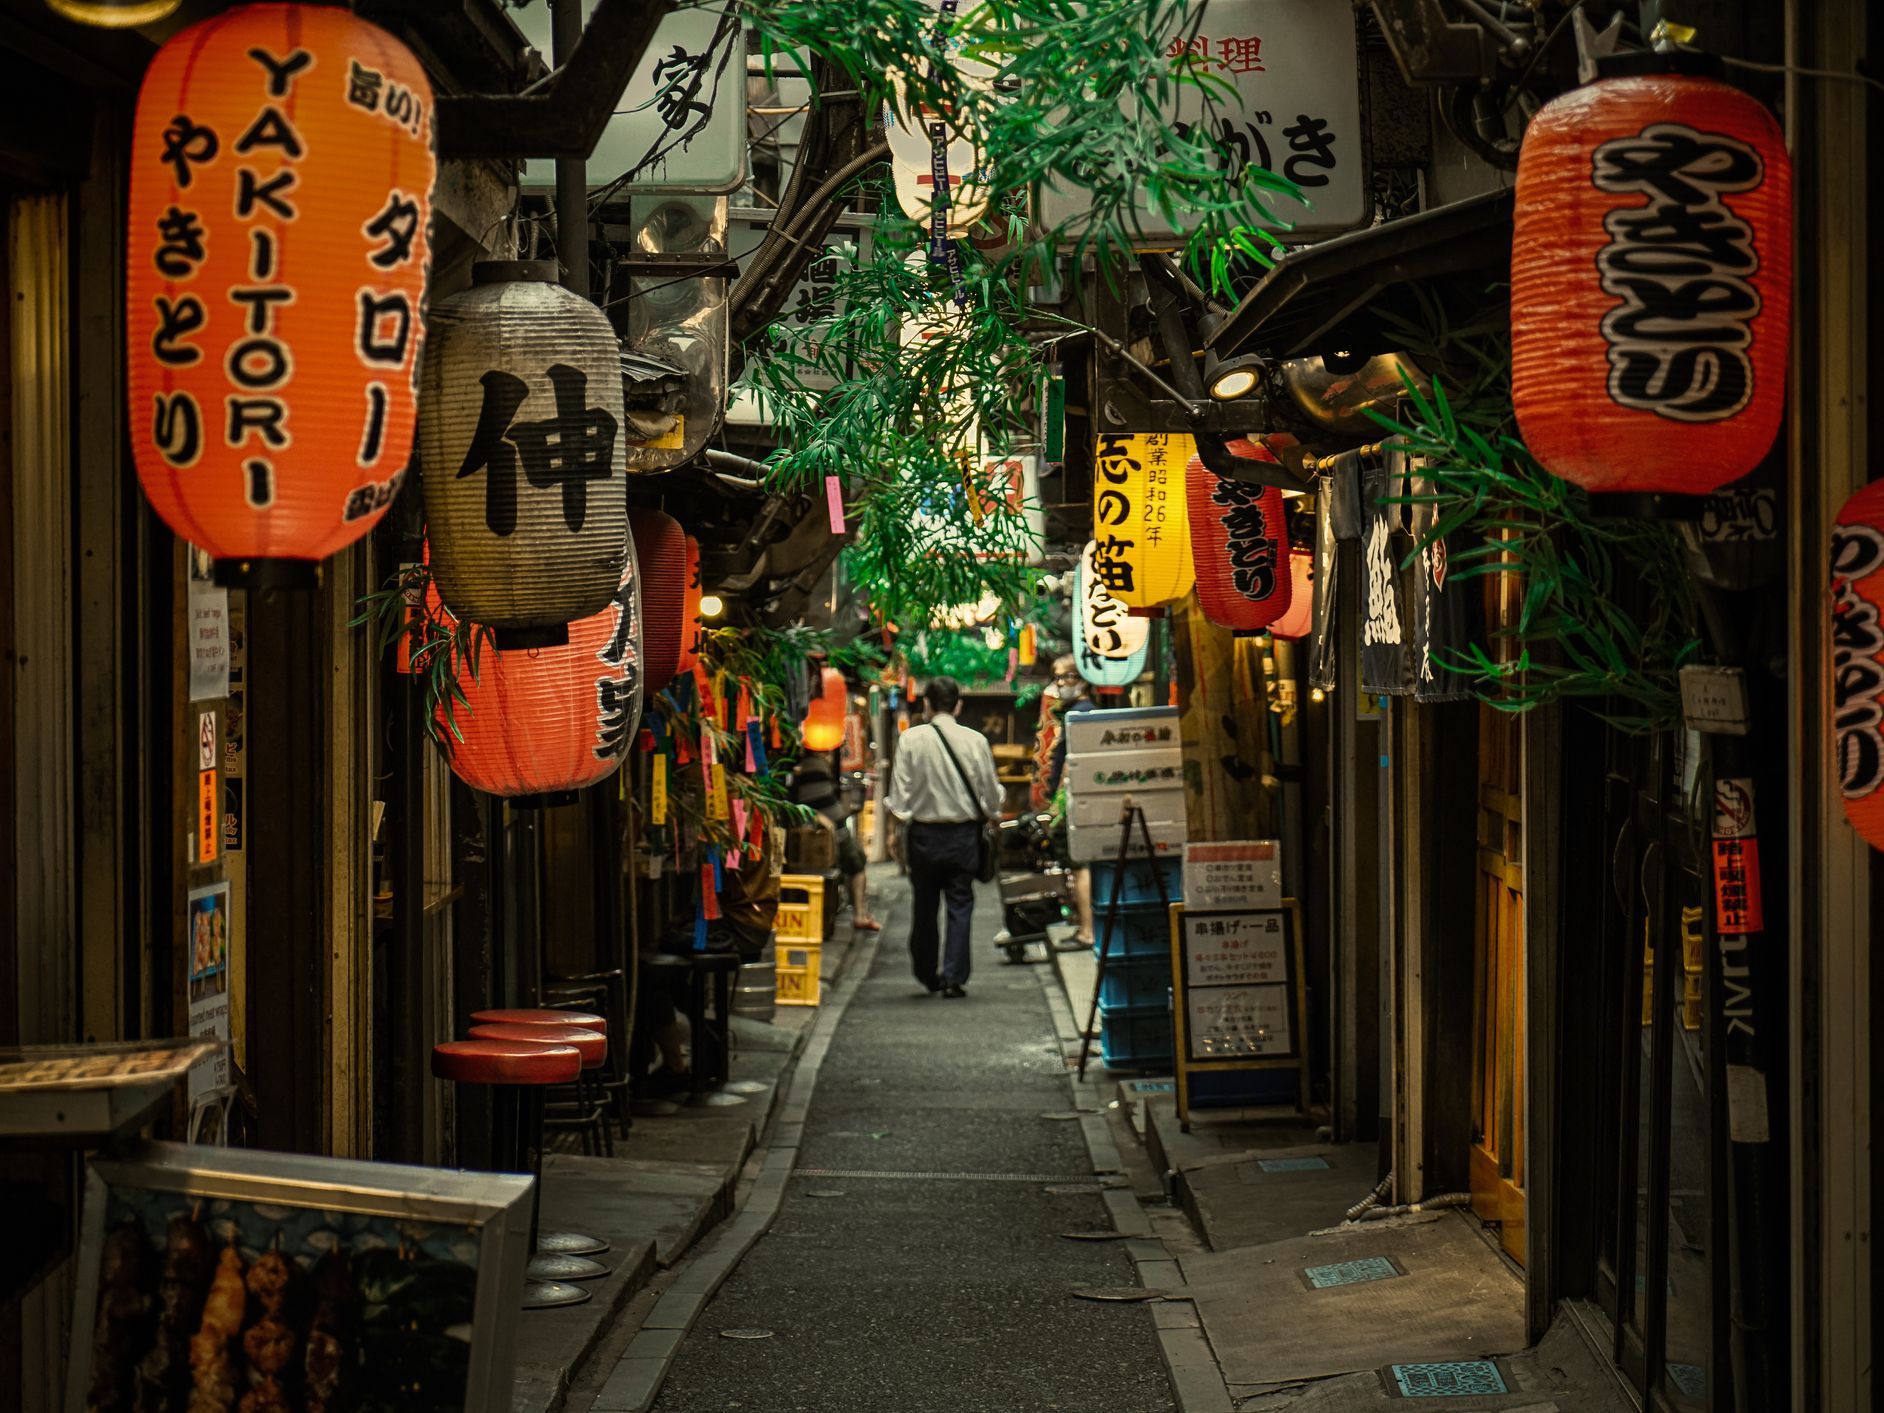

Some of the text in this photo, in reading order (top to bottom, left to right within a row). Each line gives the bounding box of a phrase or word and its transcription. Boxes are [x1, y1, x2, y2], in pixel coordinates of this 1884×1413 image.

[154, 116, 219, 467] やきとり
[229, 49, 311, 505] YAKITORI
[355, 189, 420, 468] タロー
[457, 364, 618, 536] 伸
